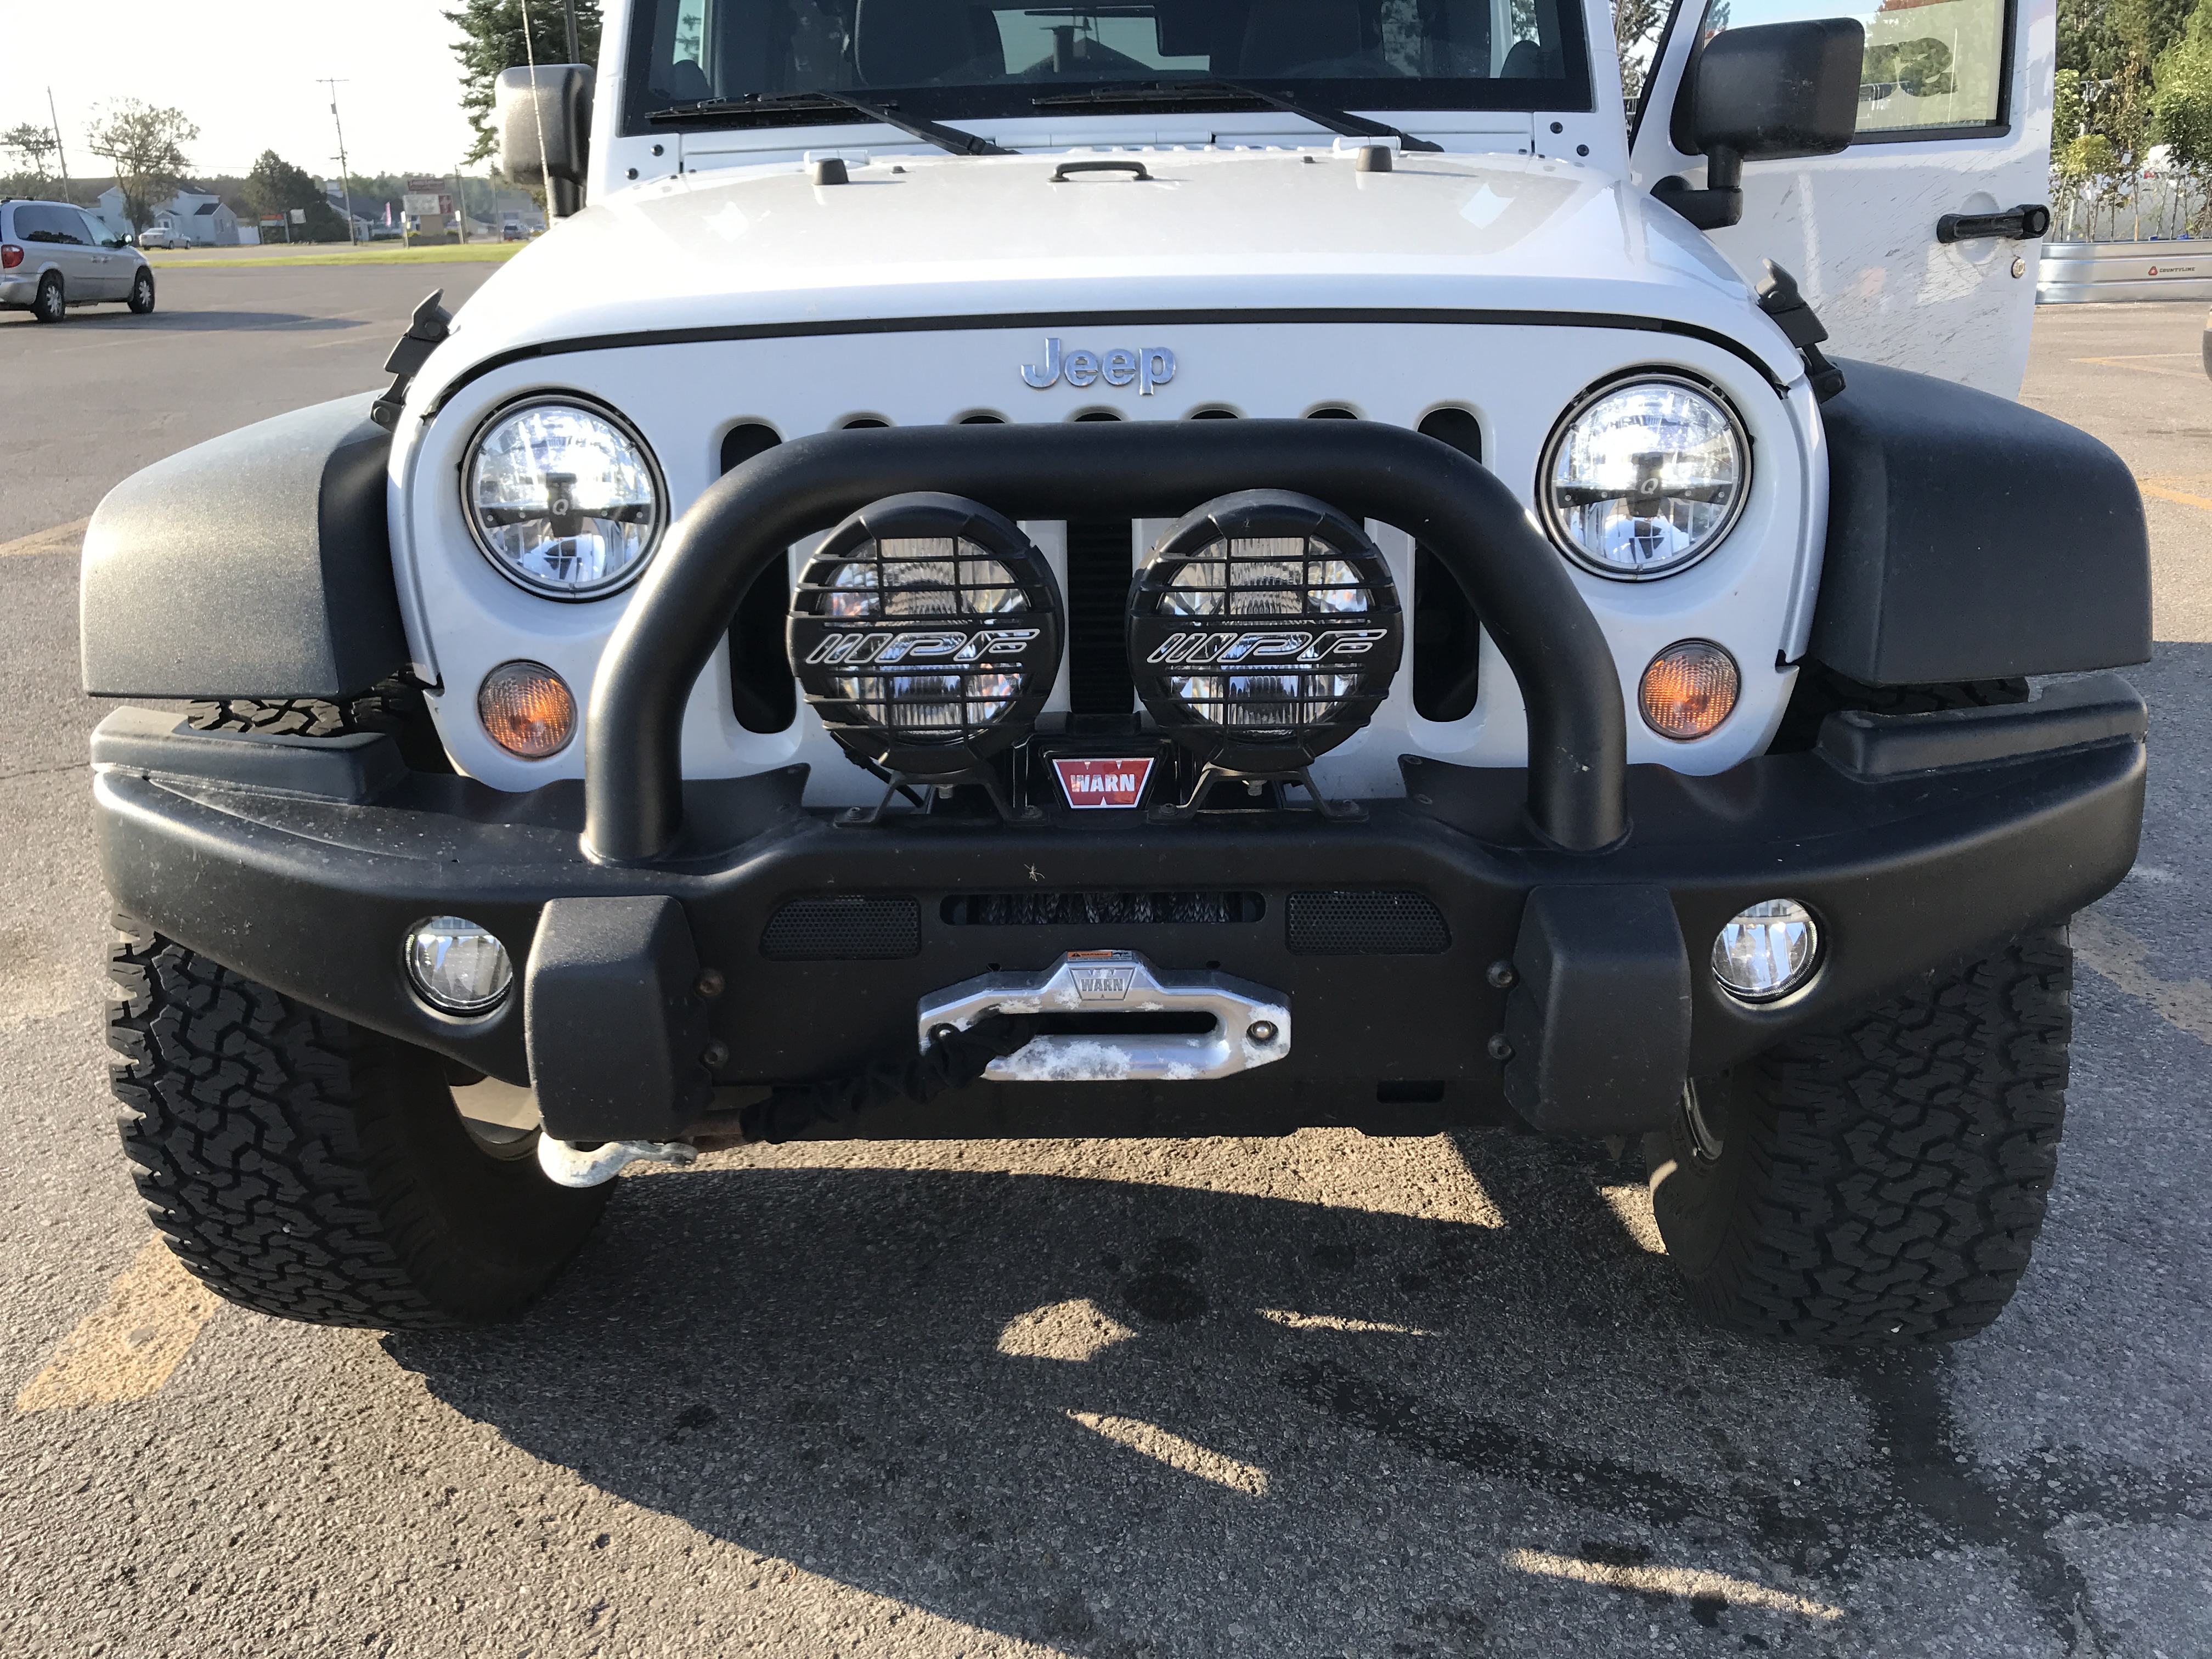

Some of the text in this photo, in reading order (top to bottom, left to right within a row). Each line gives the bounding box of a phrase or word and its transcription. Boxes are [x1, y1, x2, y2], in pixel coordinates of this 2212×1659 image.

[1021, 337, 1176, 396] Jeep
[1640, 477, 1658, 495] Q
[552, 499, 569, 516] Q
[1070, 774, 1135, 792] WARN
[1081, 978, 1123, 992] WARN
